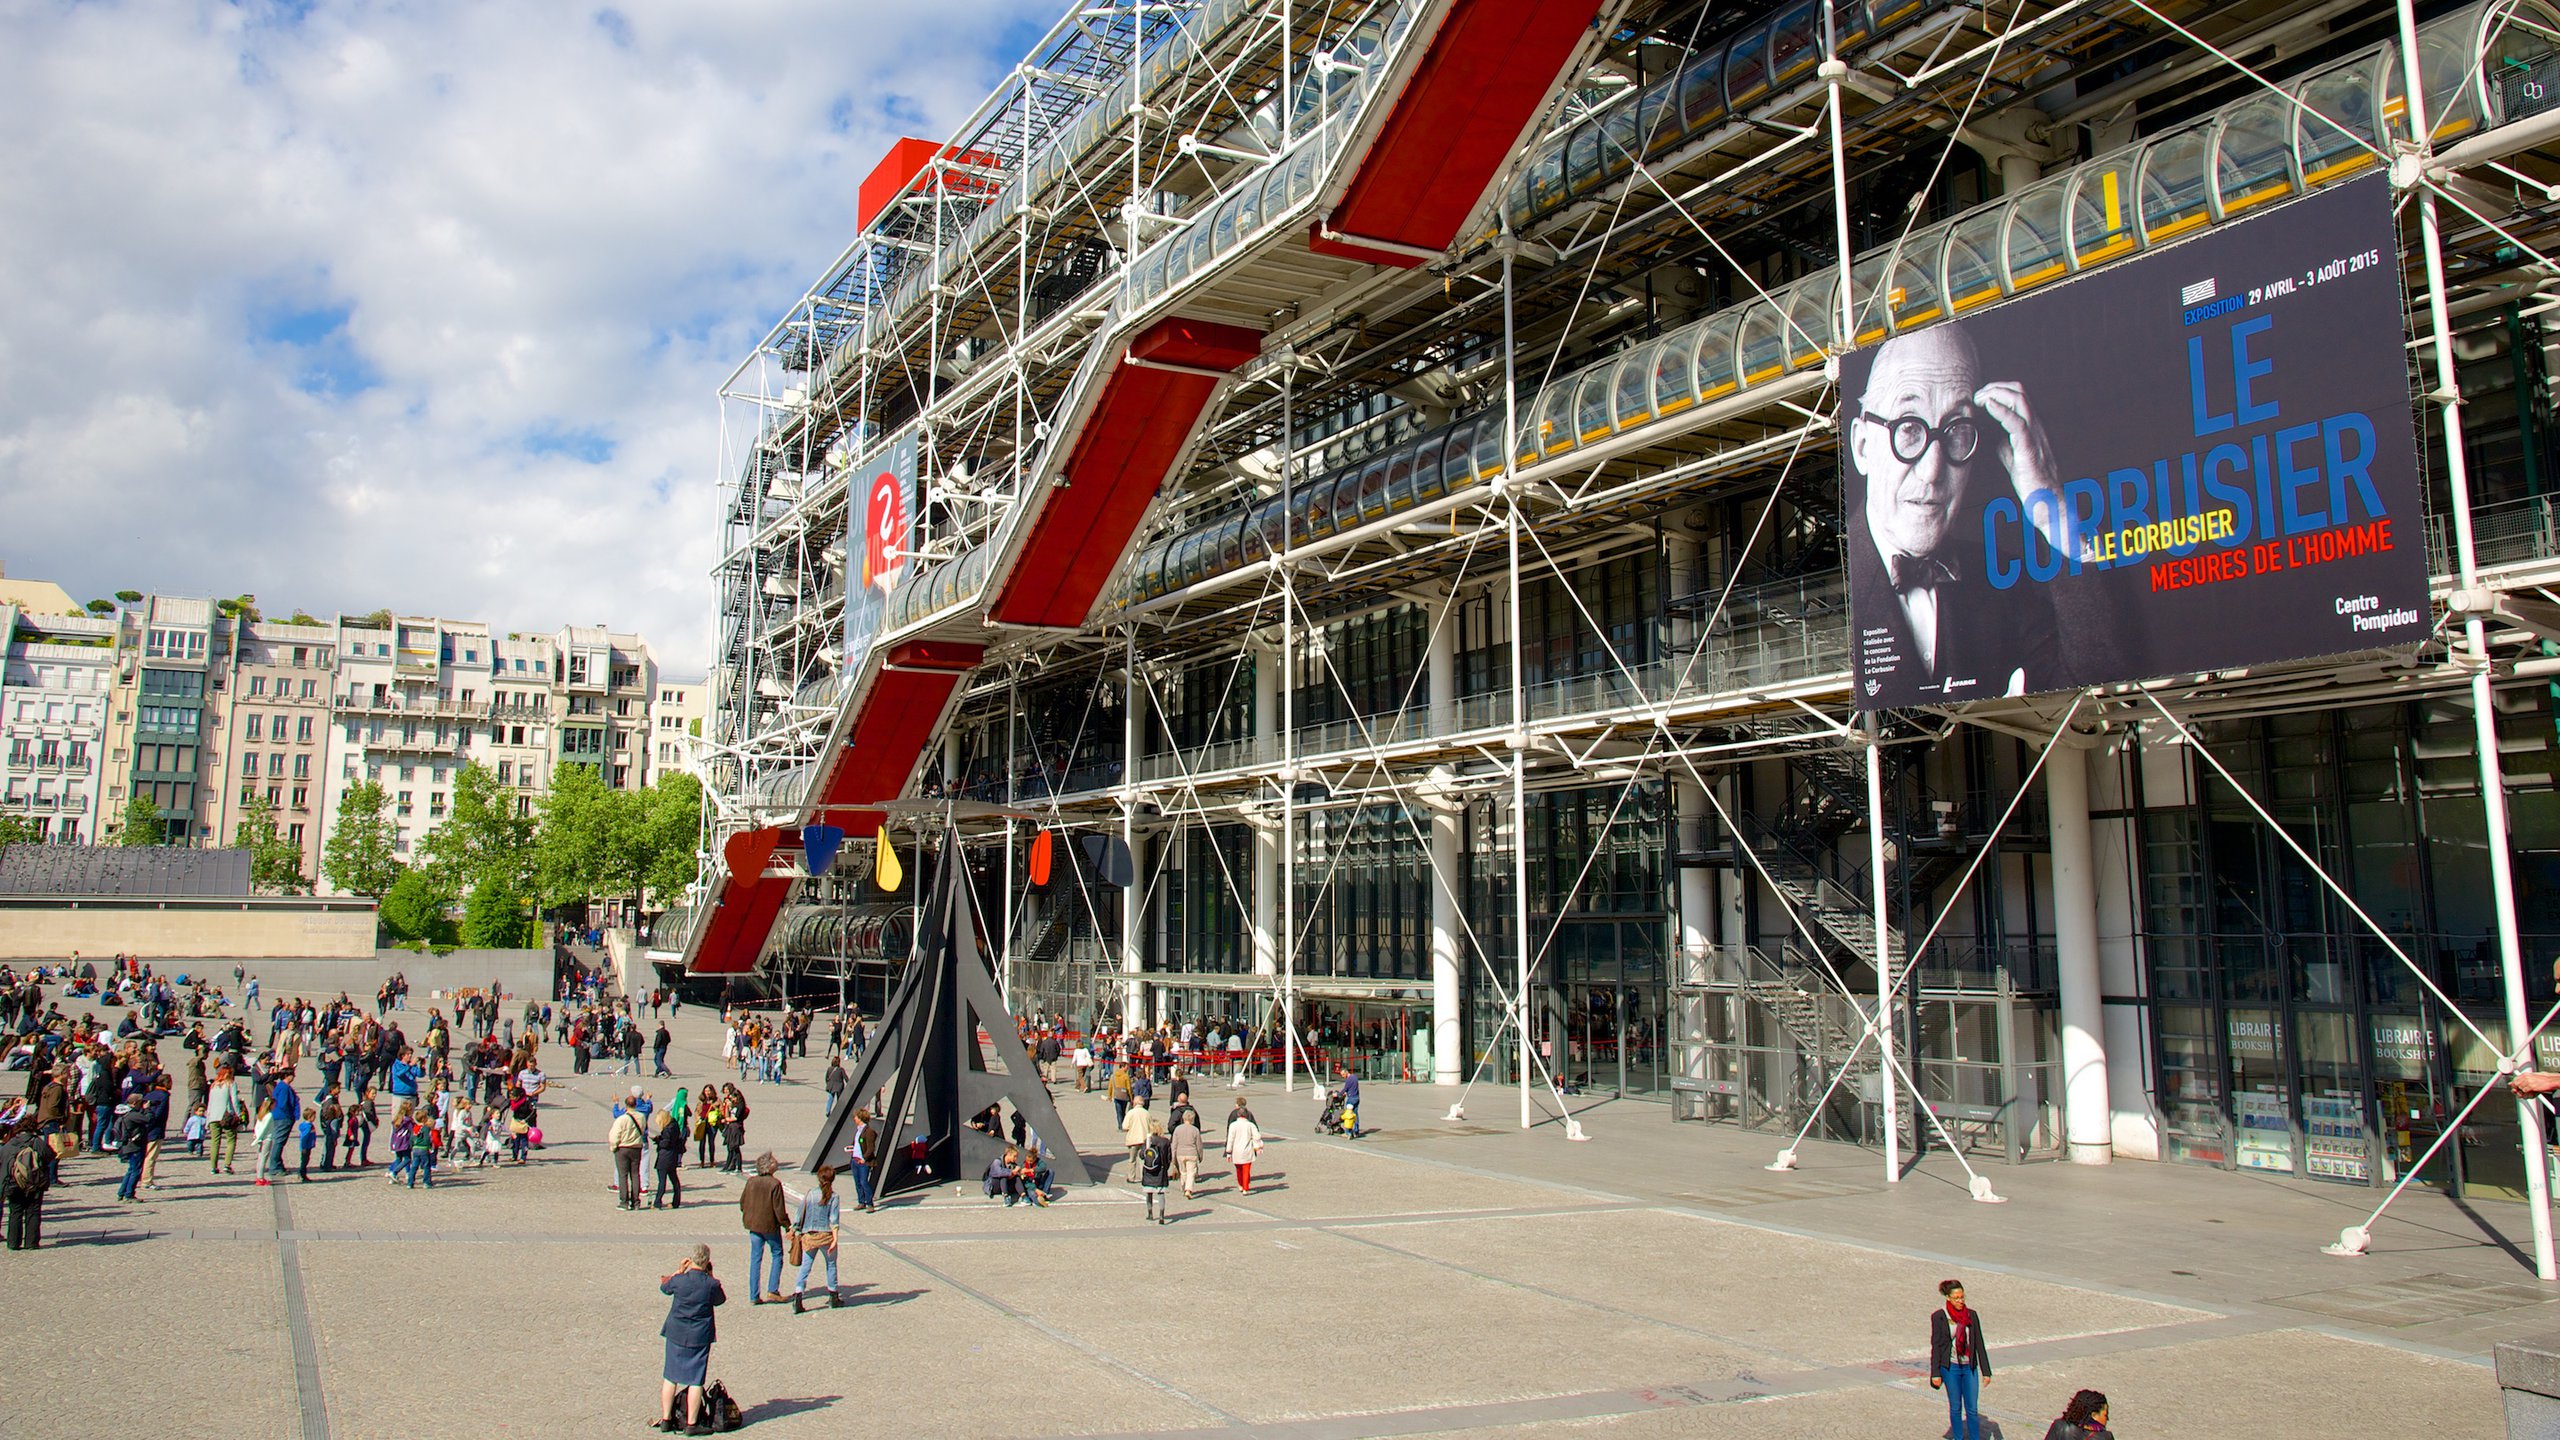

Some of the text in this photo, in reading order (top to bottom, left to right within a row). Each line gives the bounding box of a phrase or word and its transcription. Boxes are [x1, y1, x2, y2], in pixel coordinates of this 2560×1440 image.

[2184, 294, 2245, 326] EXPOSITION
[2249, 288, 2262, 305] 29
[2264, 277, 2297, 301] AVRIL
[2306, 271, 2315, 286] 3
[2317, 259, 2348, 283] AOÛT
[2350, 249, 2380, 272] 2015
[2187, 314, 2280, 438] LE
[1983, 411, 2387, 591] CORBUSIER
[2094, 509, 2235, 562] LE CORBUSIER
[2149, 519, 2395, 592] MESURES DE L'HOMME
[2335, 595, 2379, 616] Centre
[2353, 607, 2418, 633] Pompidou
[1863, 627, 1888, 637] Exposition
[1869, 646, 1892, 655] concours
[1877, 655, 1901, 664] Fondation
[1871, 665, 1896, 674] Corbusier
[2229, 1022, 2282, 1038] LIBRAIRE
[2374, 1028, 2435, 1046] LIBRAIRE
